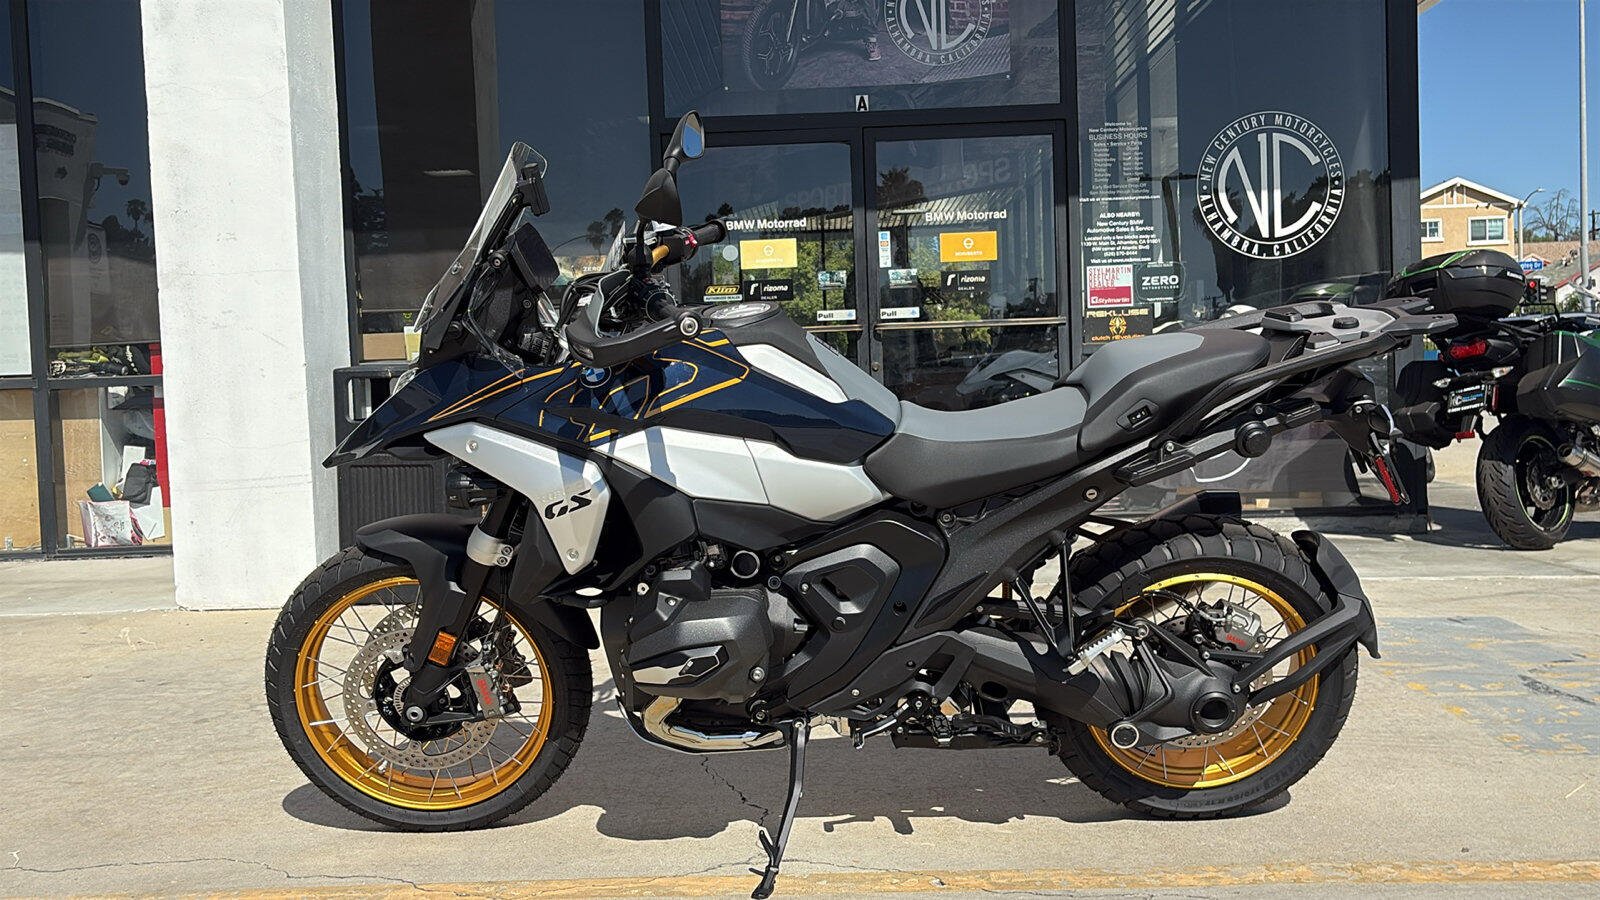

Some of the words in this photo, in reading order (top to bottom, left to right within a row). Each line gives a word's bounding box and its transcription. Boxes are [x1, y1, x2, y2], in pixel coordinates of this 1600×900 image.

[940, 13, 990, 63] CALIFORNIA
[857, 95, 868, 112] A
[1201, 154, 1216, 181] NEW
[1215, 115, 1265, 150] CENTURY
[1275, 114, 1341, 178] MOTORCYCLES
[925, 212, 954, 222] BMW
[957, 209, 1007, 220] Motorrad
[1200, 194, 1266, 257] ALHAMBRA,
[1274, 189, 1342, 256] CALIFORNIA
[726, 220, 755, 230] BMW
[757, 218, 807, 229] Motorrad
[1088, 266, 1131, 275] STYLMARTIN
[1142, 275, 1178, 286] ZERO
[1087, 308, 1149, 318] REKLUSE
[544, 488, 592, 520] GS
